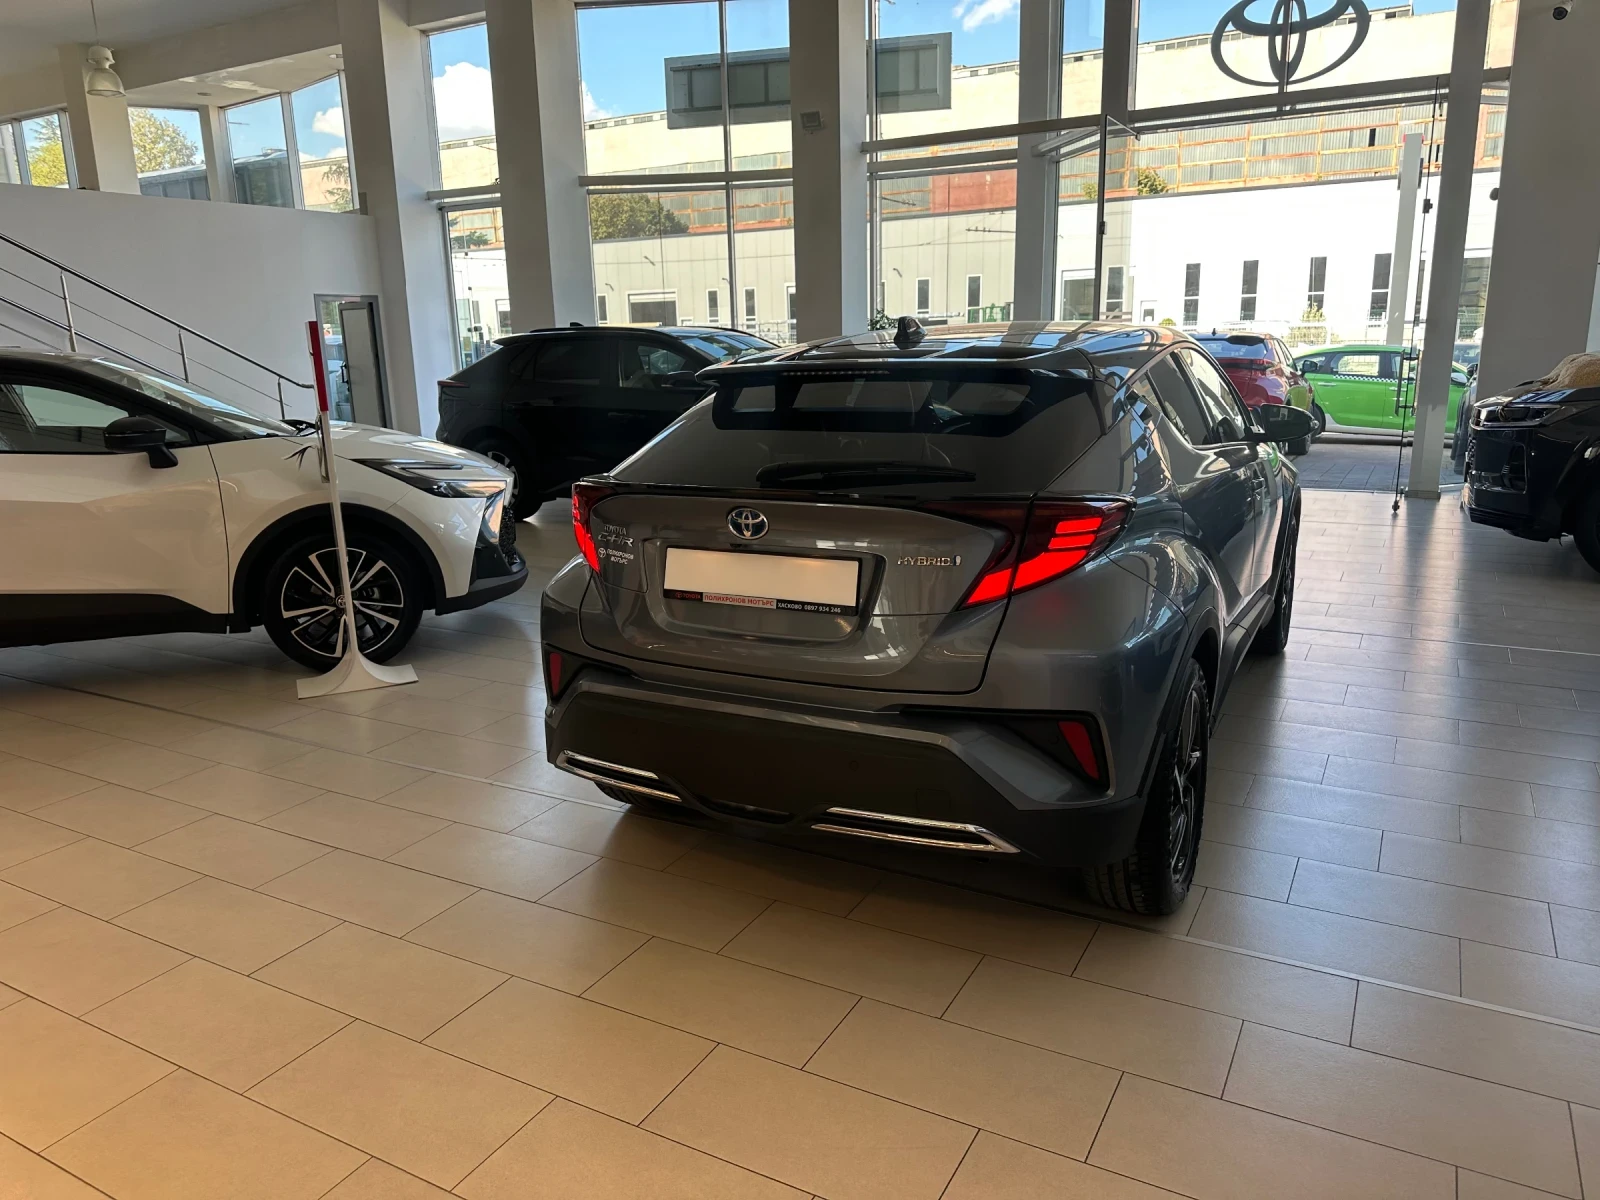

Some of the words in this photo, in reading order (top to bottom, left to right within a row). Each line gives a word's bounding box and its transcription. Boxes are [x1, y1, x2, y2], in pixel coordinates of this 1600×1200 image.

[604, 524, 627, 535] TOYOTA
[897, 556, 951, 566] HYBRID
[704, 594, 746, 604] ПОЛИХРОНОВ
[747, 598, 774, 607] МОТЪРС
[777, 602, 802, 610] ХАСКОВО
